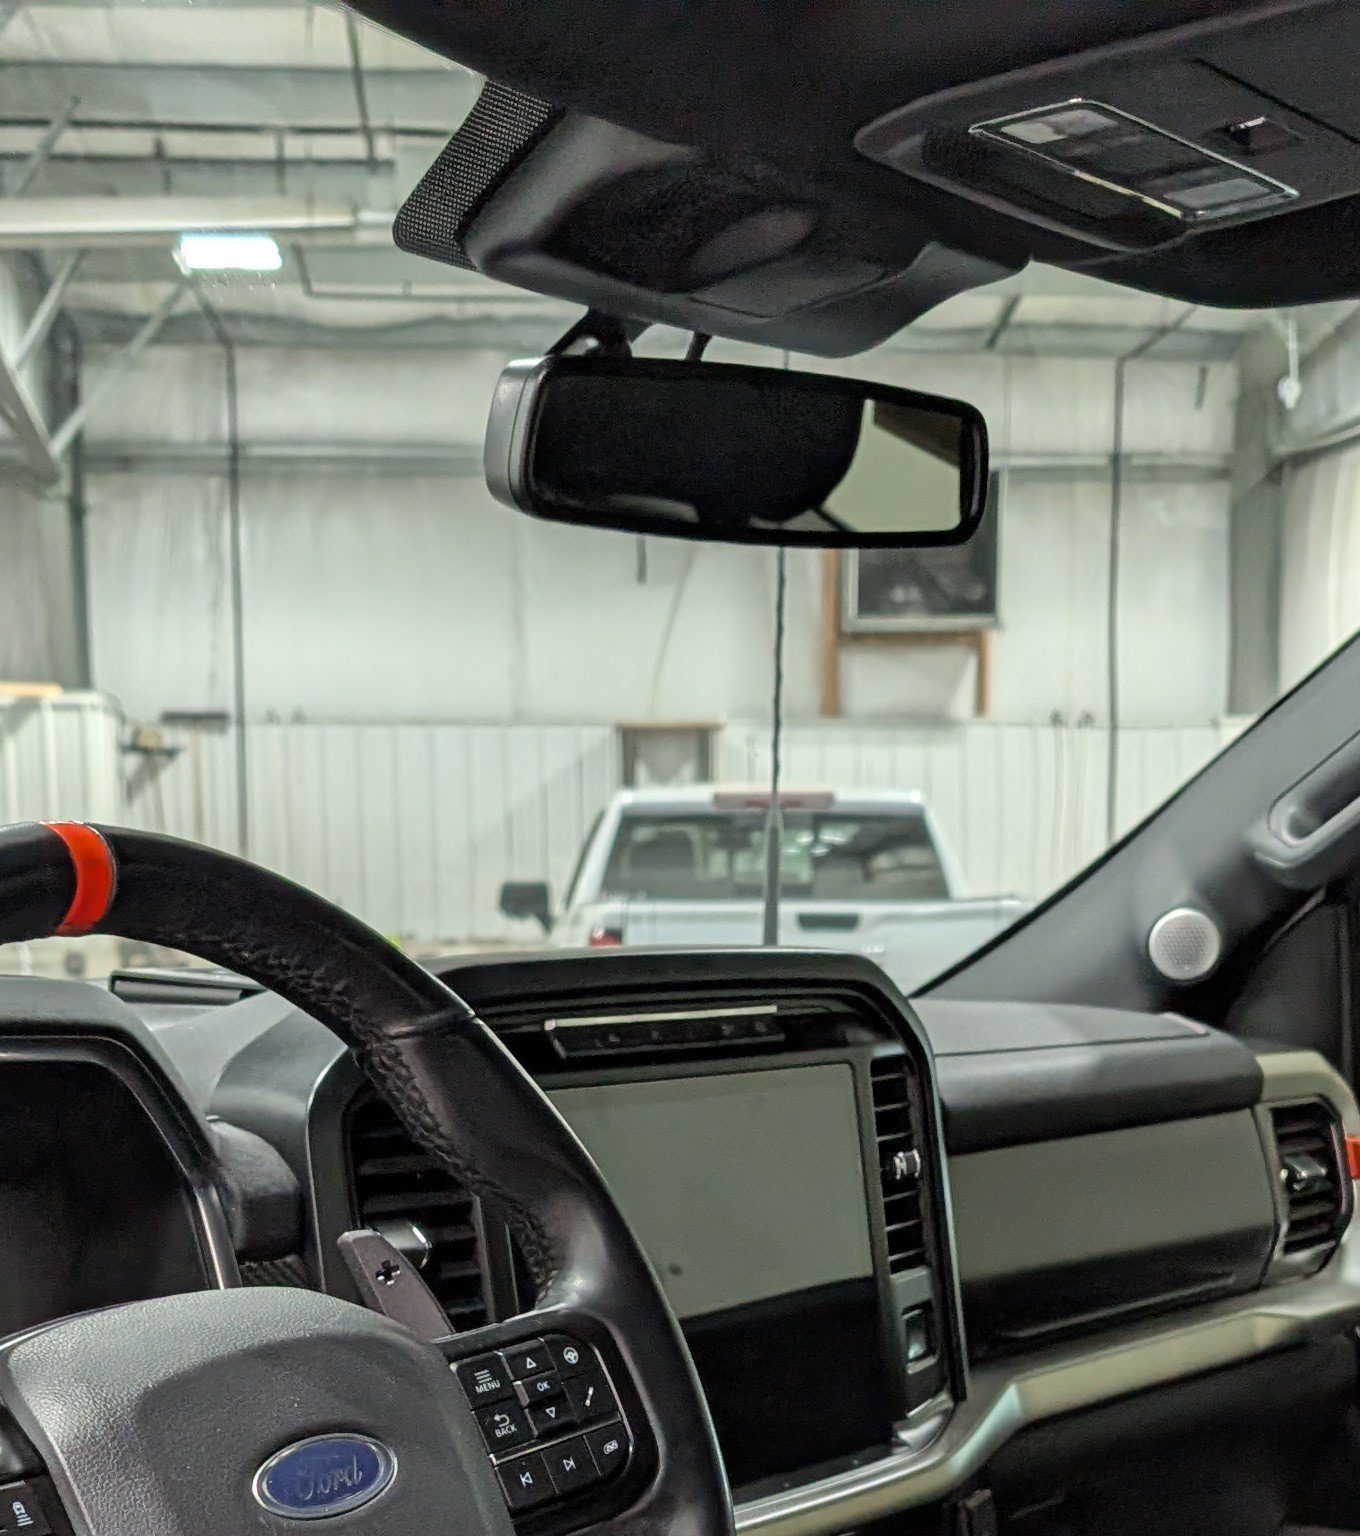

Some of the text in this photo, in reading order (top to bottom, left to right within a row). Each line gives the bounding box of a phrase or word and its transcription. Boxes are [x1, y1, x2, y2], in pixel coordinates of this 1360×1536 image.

[474, 1379, 501, 1394] MENU
[536, 1380, 551, 1392] OK
[494, 1424, 518, 1438] BACK
[293, 1453, 363, 1501] Ford
